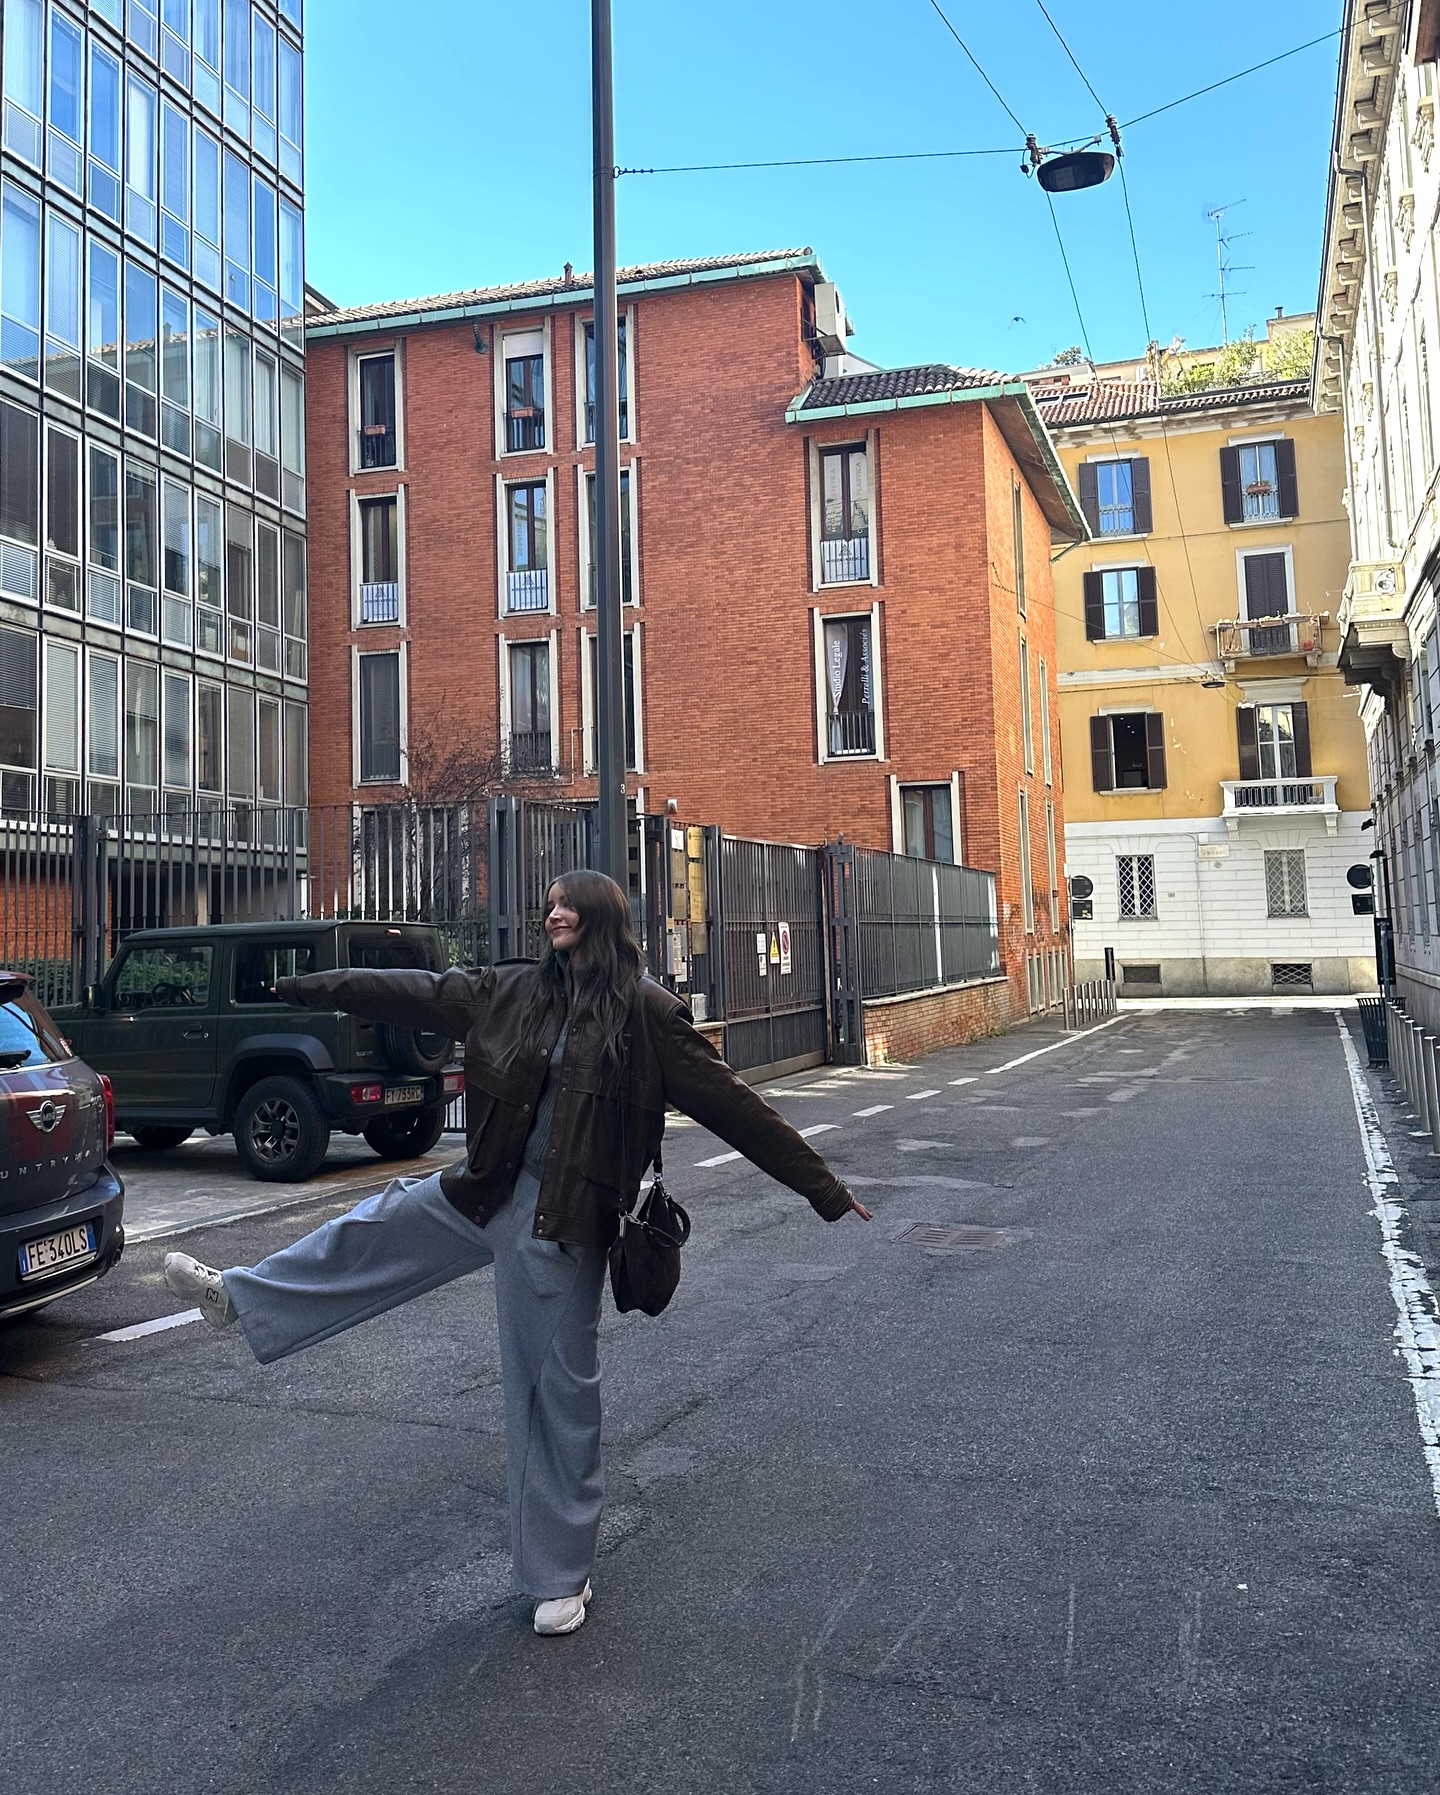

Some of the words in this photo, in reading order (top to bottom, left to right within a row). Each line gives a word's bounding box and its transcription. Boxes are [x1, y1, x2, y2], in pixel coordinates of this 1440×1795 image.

[832, 640, 843, 668] Legale
[860, 664, 869, 674] &
[833, 670, 842, 698] Studio
[861, 676, 870, 705] Perrelli
[620, 783, 626, 795] 3
[206, 1287, 219, 1303] N
